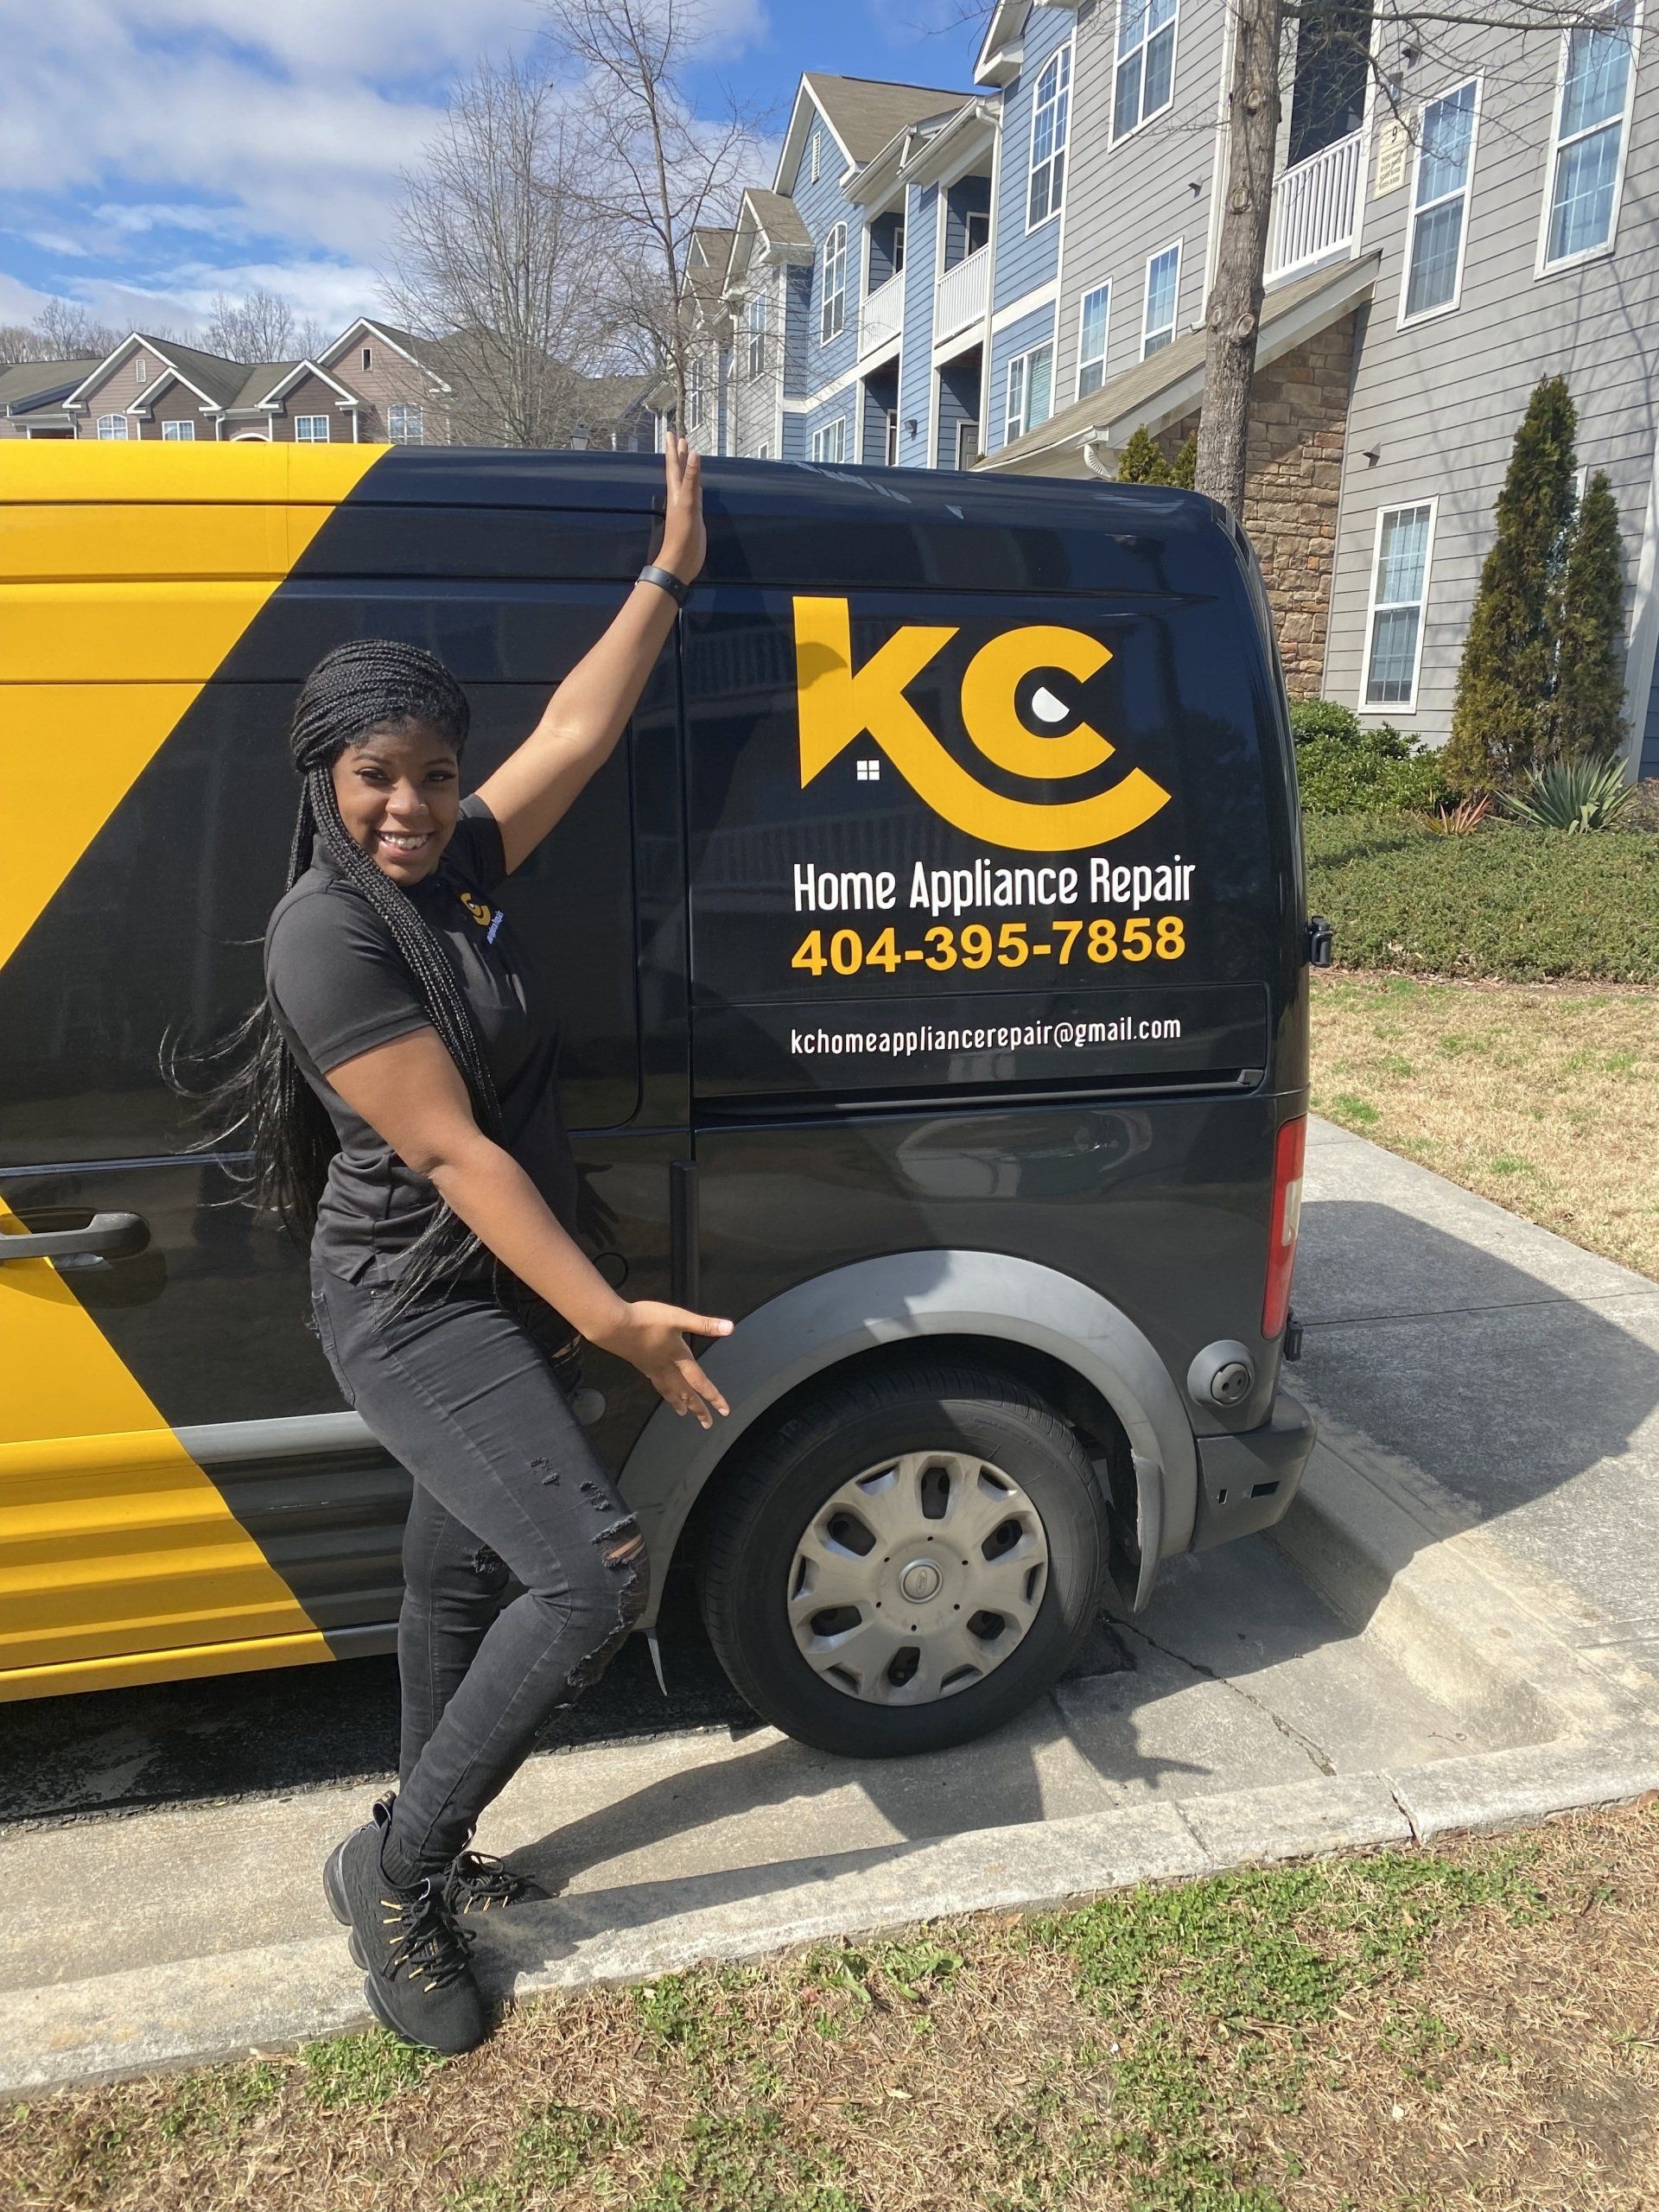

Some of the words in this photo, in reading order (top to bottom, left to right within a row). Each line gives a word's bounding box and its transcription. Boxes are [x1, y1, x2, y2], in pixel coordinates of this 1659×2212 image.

[1392, 126, 1397, 143] 9
[793, 863, 896, 912] Home
[909, 859, 1078, 917] Appliance
[1090, 854, 1196, 912] Repair
[791, 916, 1185, 976] 404-395-7858
[791, 1017, 1181, 1057] kchomeappliancerepair@gmail.com
